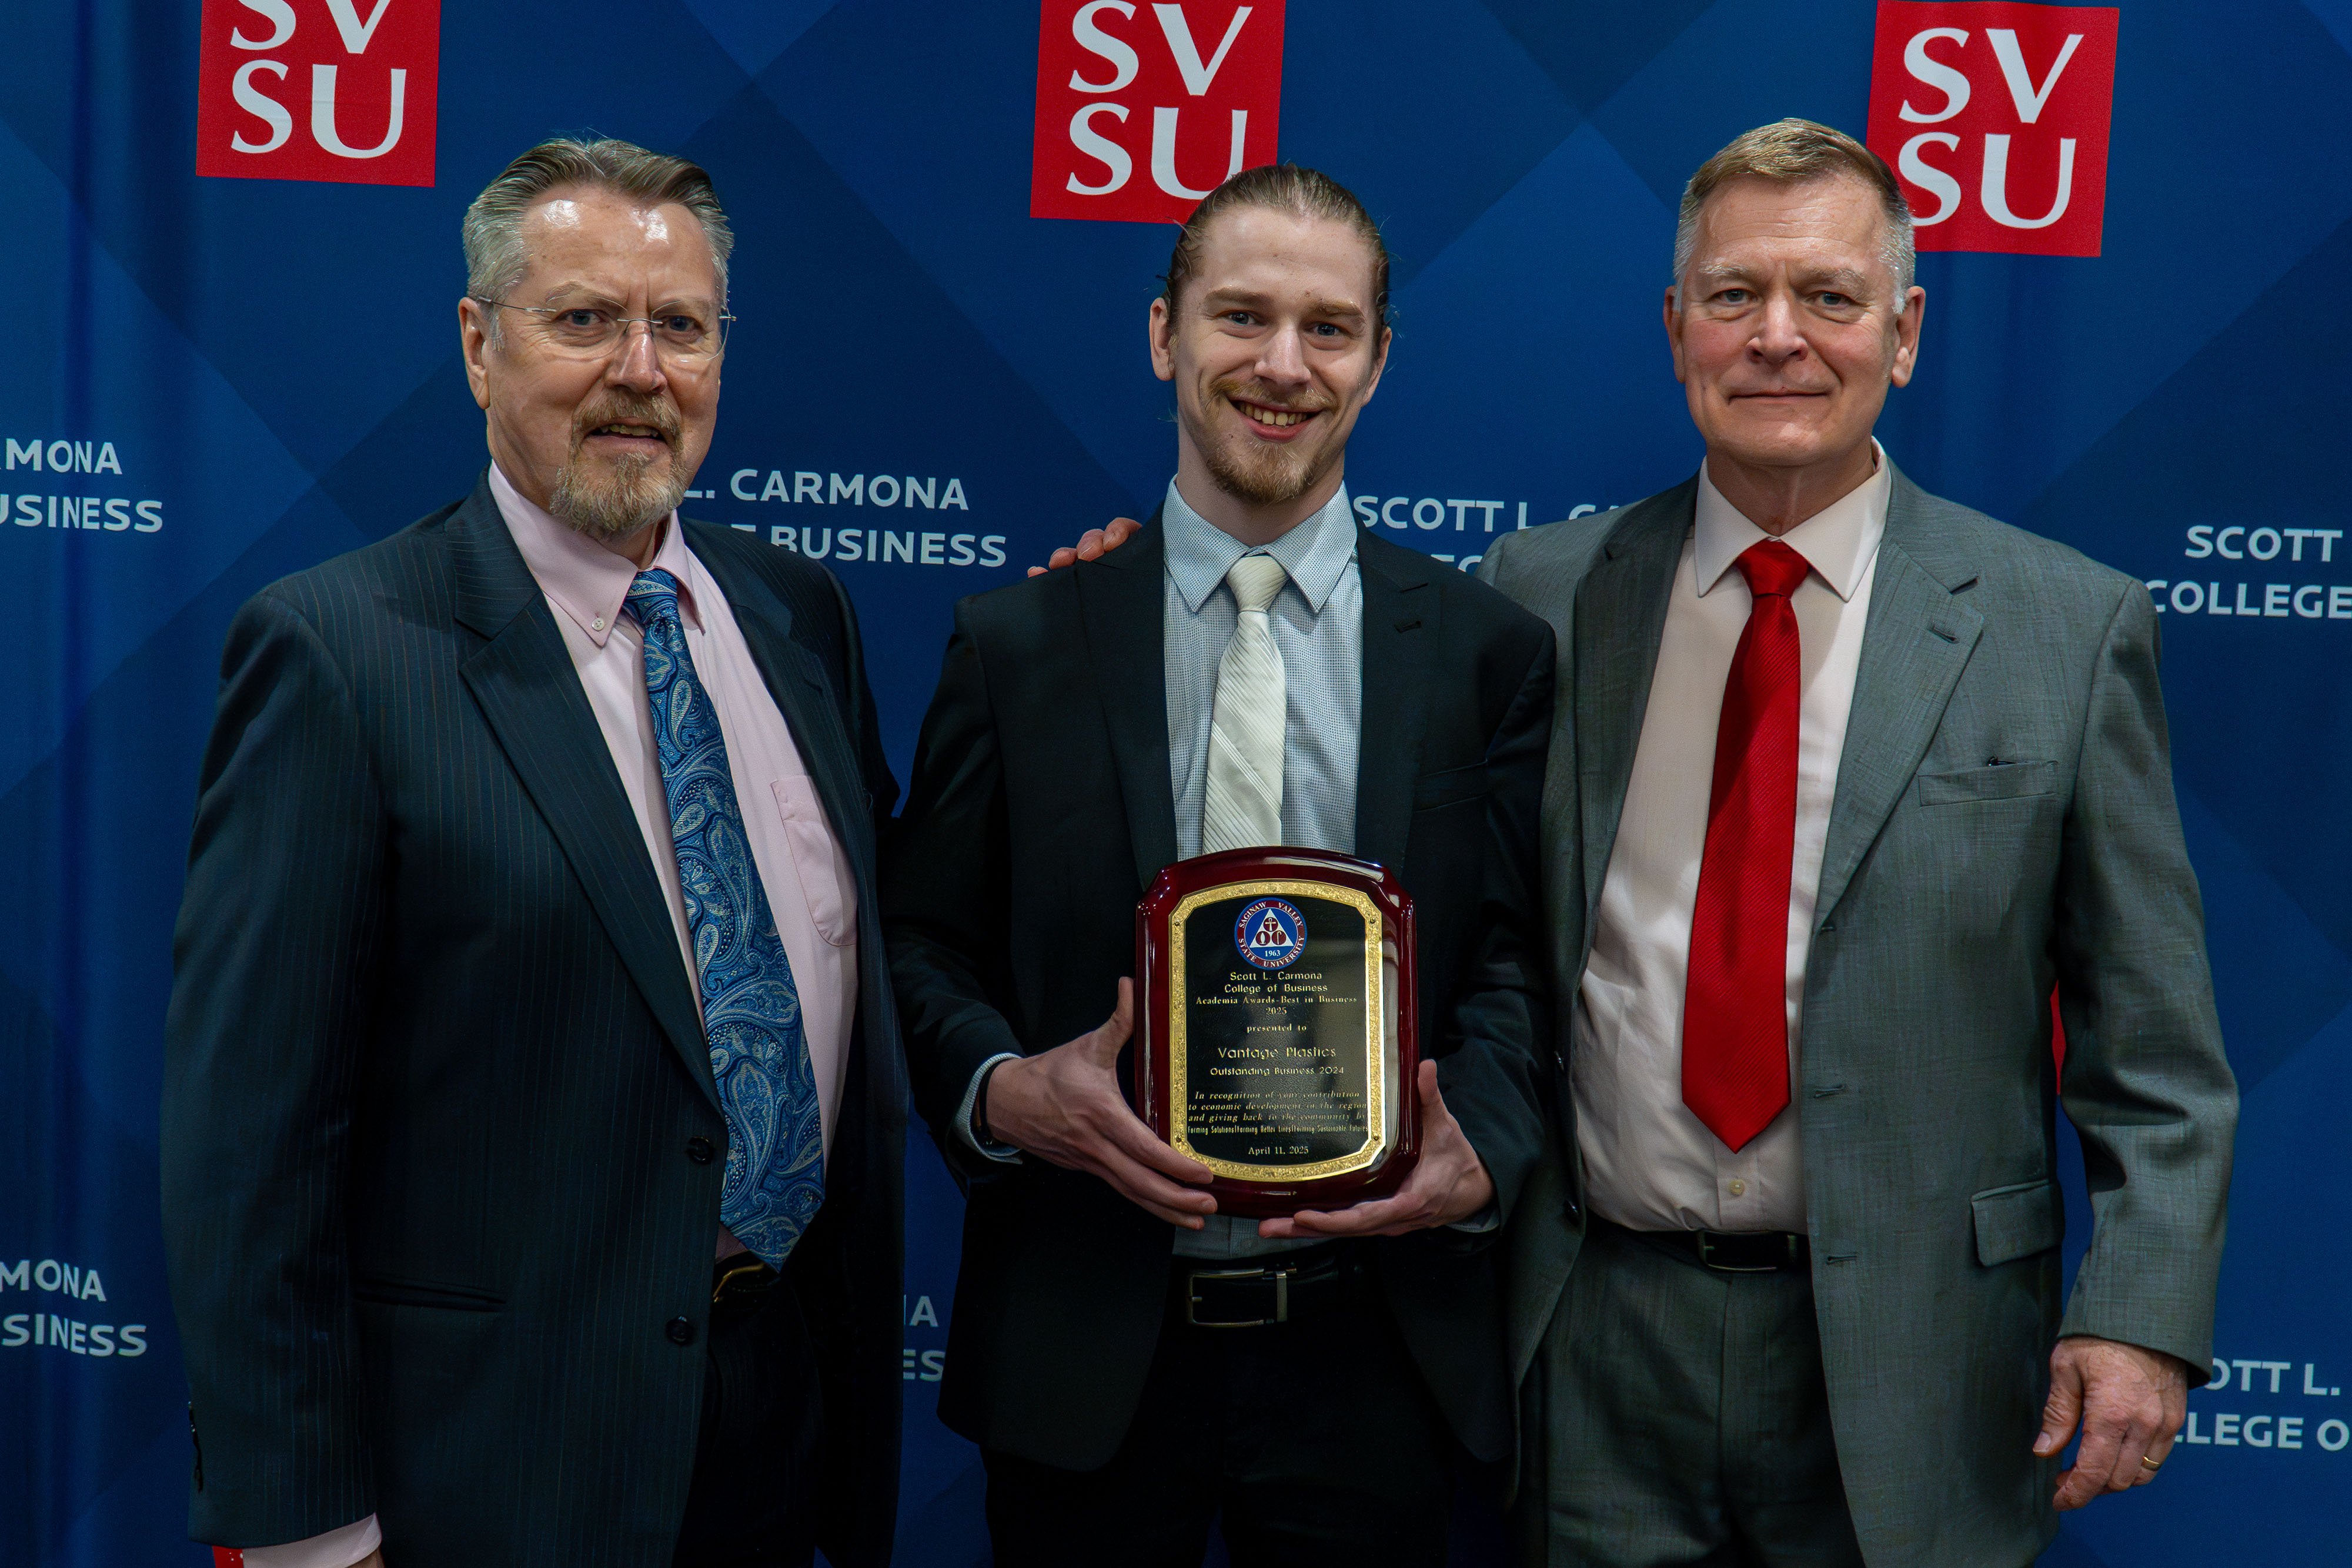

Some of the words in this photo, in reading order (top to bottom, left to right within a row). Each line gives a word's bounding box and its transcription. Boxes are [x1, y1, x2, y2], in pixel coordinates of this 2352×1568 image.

[1068, 0, 1253, 96] SV
[1899, 27, 2084, 124] SV
[231, 59, 406, 159] SU
[1066, 102, 1248, 200] SU
[1898, 132, 2076, 229] SU
[730, 469, 968, 510] CARMONA
[1353, 496, 1504, 532] SCOTT
[771, 526, 1006, 567] BUSINESS
[2185, 525, 2343, 561] SCOTT
[2145, 580, 2352, 619] COLLEGE
[1239, 901, 1267, 928] SAGINAW
[1278, 902, 1304, 927] VALLEY
[1238, 938, 1257, 962] STATE
[1264, 935, 1304, 967] UNIVERSITY
[1225, 984, 1261, 994] College
[1267, 984, 1278, 992] of
[1284, 984, 1328, 992] Business
[1230, 972, 1257, 981] Scott
[1263, 972, 1271, 980] L.
[1278, 971, 1322, 980] Carmona
[1247, 1023, 1292, 1033] presented
[1218, 1047, 1279, 1059] Vantage
[1286, 1047, 1336, 1058] Plastics
[1210, 1067, 1269, 1076] Outstanding
[1275, 1066, 1315, 1075] Business
[1195, 1091, 1204, 1099] In
[1210, 1091, 1260, 1101] recognition
[1201, 1102, 1241, 1111] economic
[1246, 1102, 1301, 1111] development
[1188, 1126, 1208, 1135] Forming
[1209, 1114, 1238, 1123] giving
[1248, 1146, 1270, 1156] April
[1289, 1146, 1309, 1154] 2025
[2304, 1363, 2340, 1395] L.
[2175, 1412, 2304, 1449] LEGE
